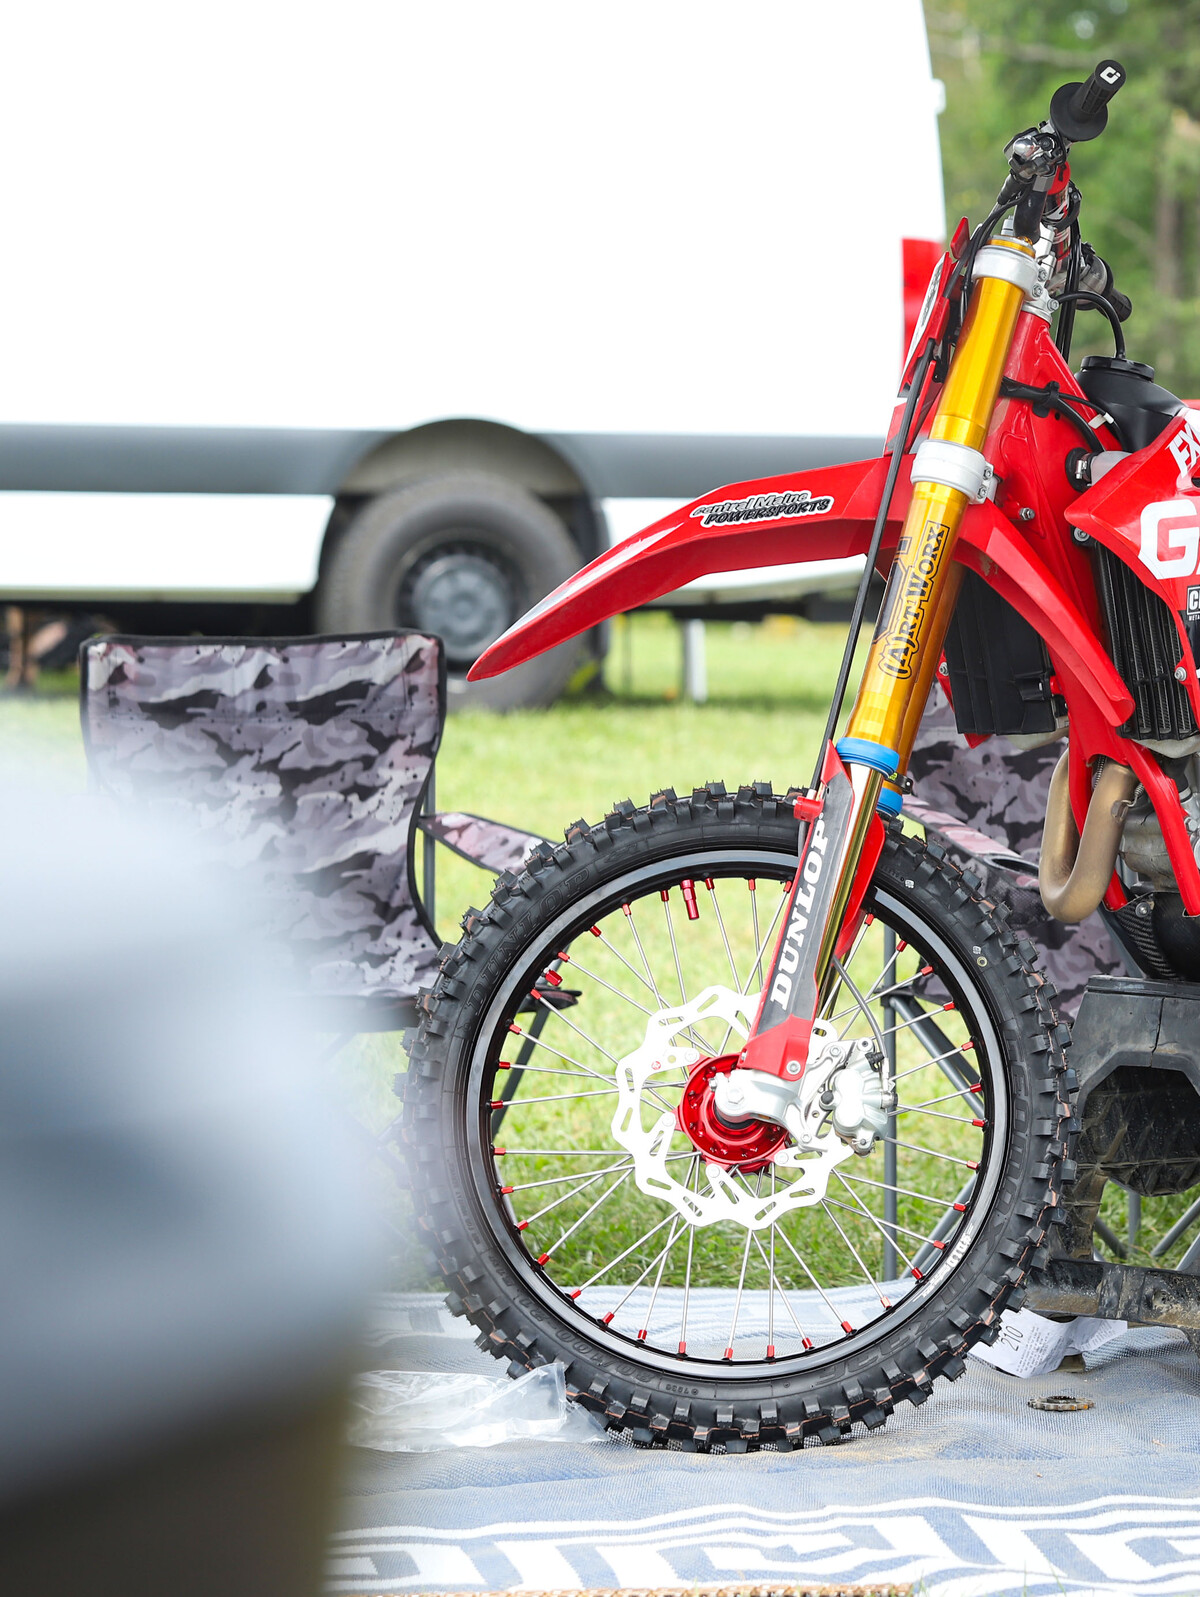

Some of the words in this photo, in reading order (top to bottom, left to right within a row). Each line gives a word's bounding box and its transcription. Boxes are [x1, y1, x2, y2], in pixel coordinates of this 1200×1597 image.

[693, 497, 754, 517] Central
[755, 492, 809, 510] Maine
[704, 498, 831, 525] POWERSPORTS
[769, 819, 829, 1011] DUNLOP
[461, 866, 592, 1016] DUNLOP
[1000, 1325, 1024, 1352] 210
